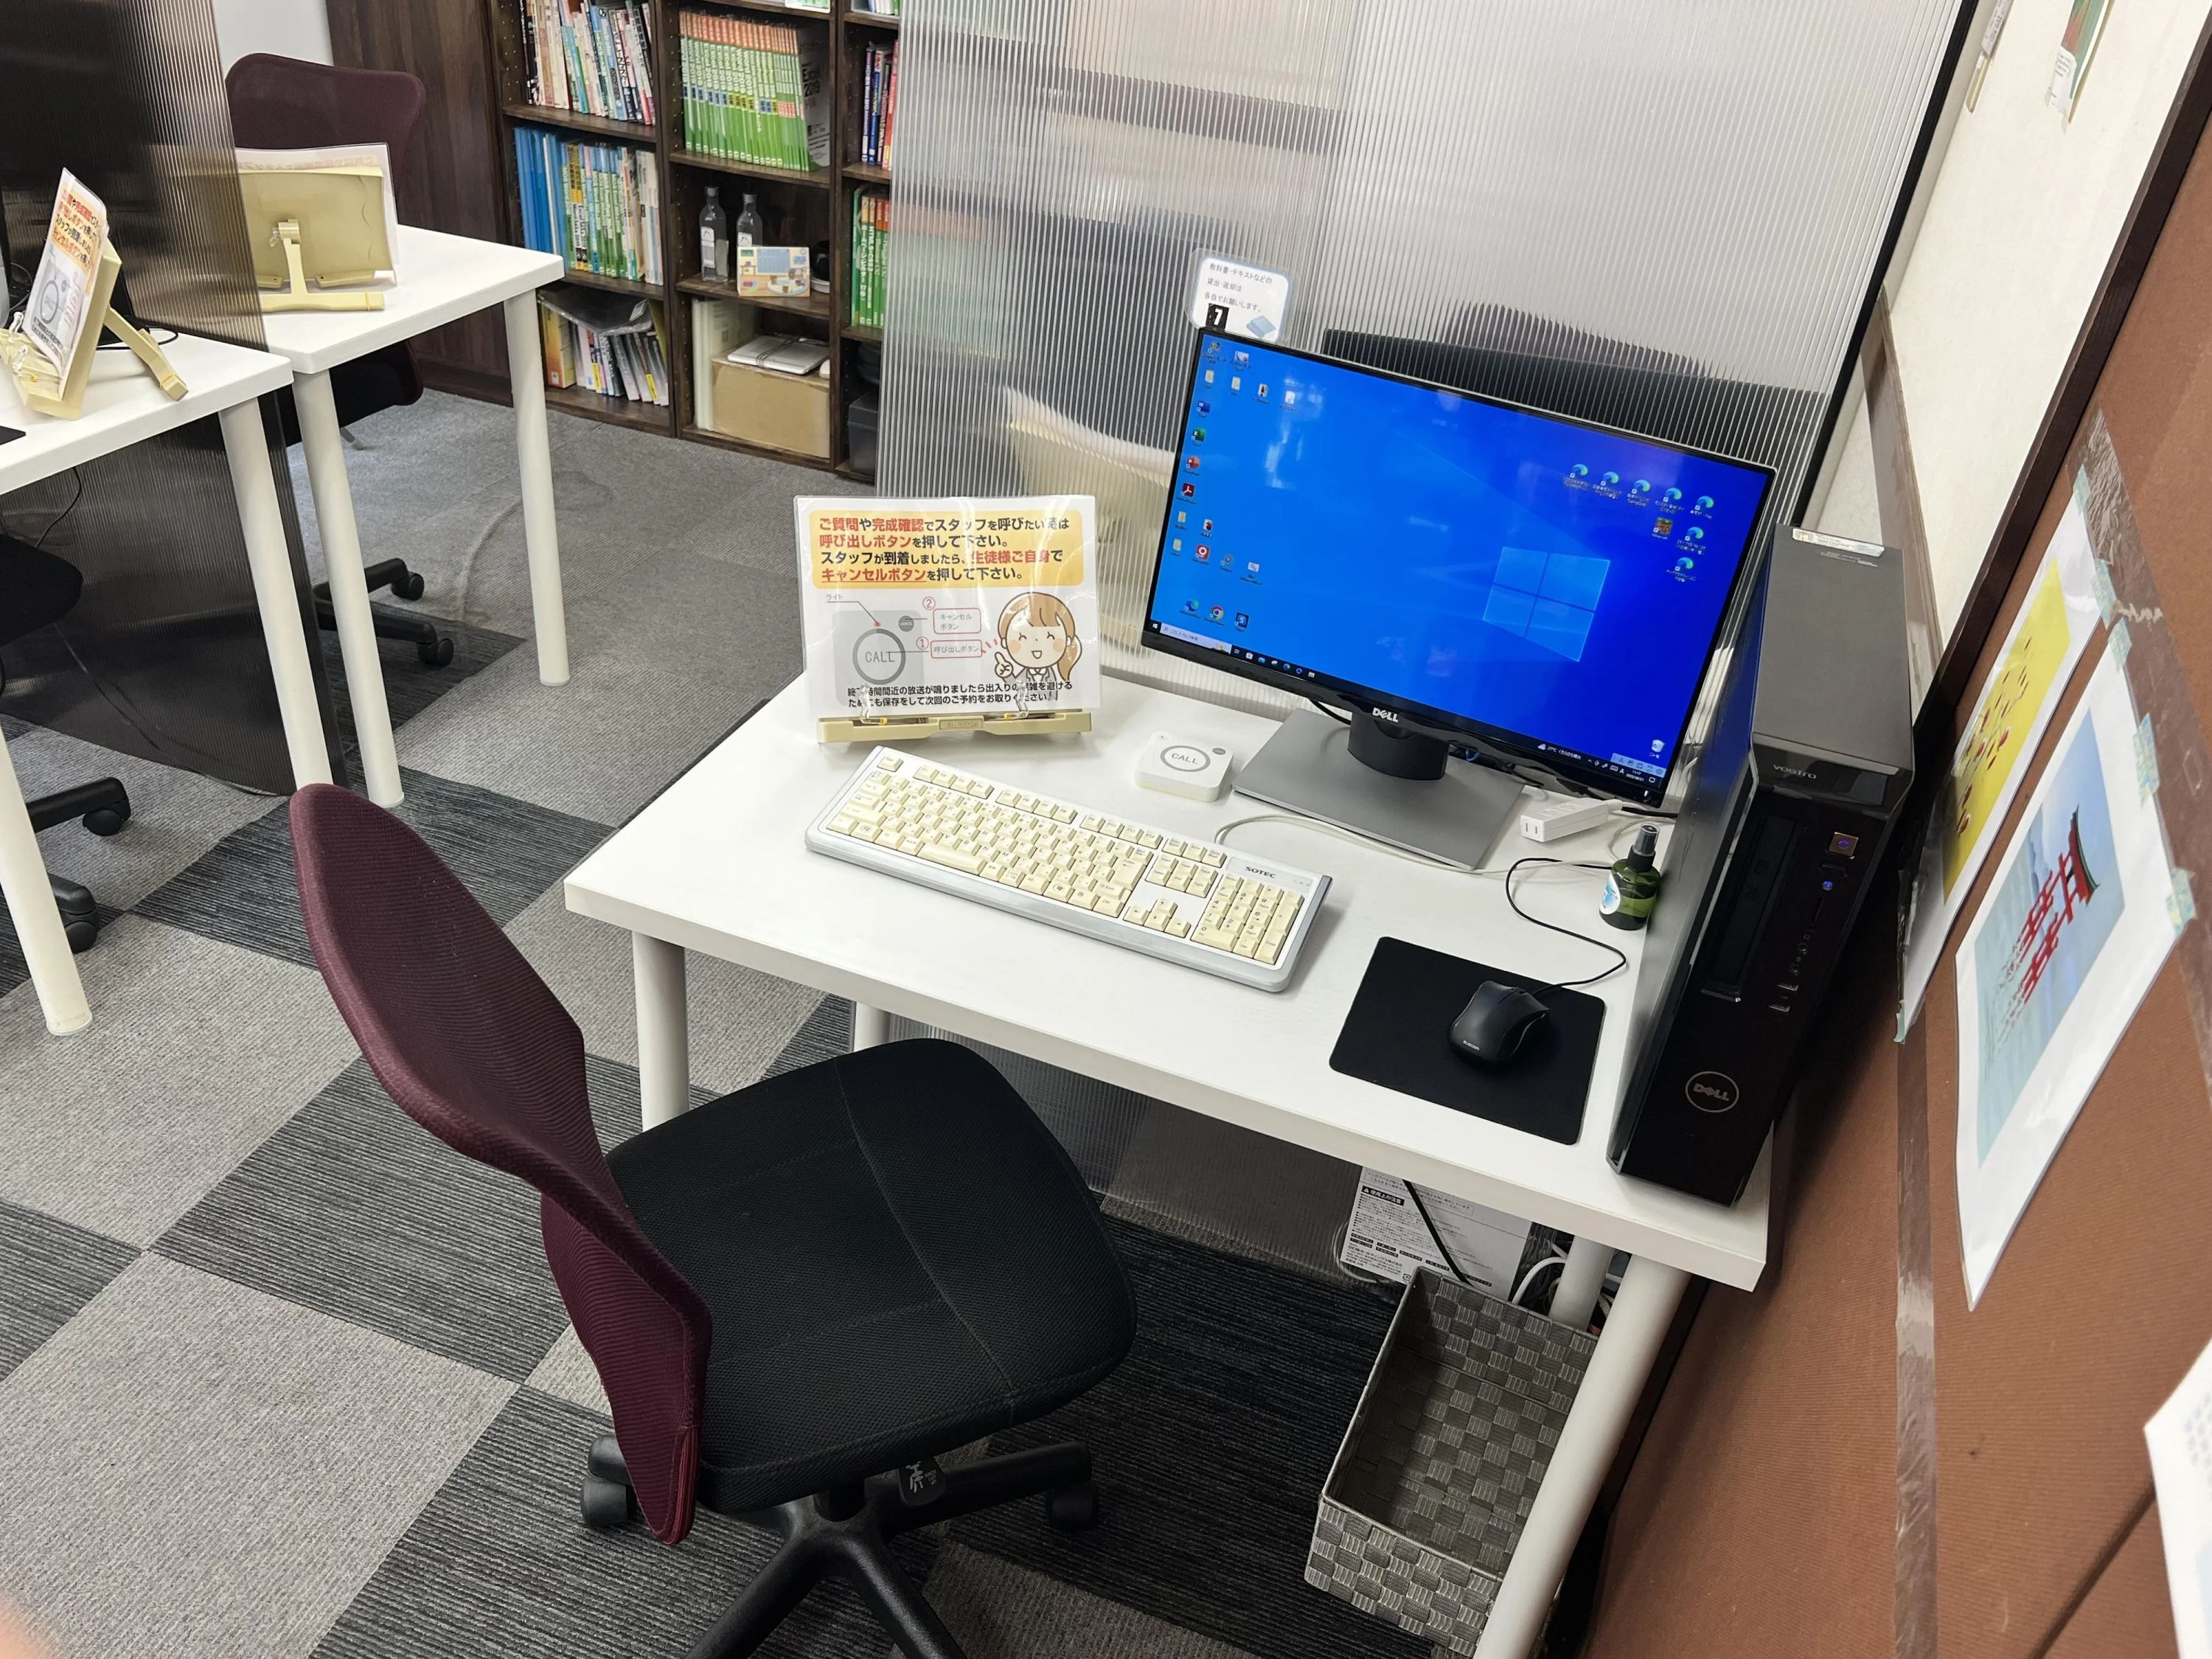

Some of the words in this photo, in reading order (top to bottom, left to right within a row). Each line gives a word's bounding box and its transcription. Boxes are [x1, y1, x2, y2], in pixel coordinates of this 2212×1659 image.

[820, 534, 1008, 549] 呼び出しボタンを押して下さい。
[821, 549, 1062, 565] スタッフが到着しましたら、生徒様ご自身で
[821, 567, 1023, 582] キャンセルボタンを押して下さい。
[933, 645, 979, 653] 呼び出しボタン
[865, 651, 895, 663] CALL
[848, 681, 1073, 697] 終間間近の放送が鳴りましたら出入りの雑を避ける
[1372, 707, 1399, 723] DELL
[1171, 753, 1198, 764] CALL
[1246, 866, 1277, 879] SOTEC
[1693, 1083, 1730, 1101] DELL
